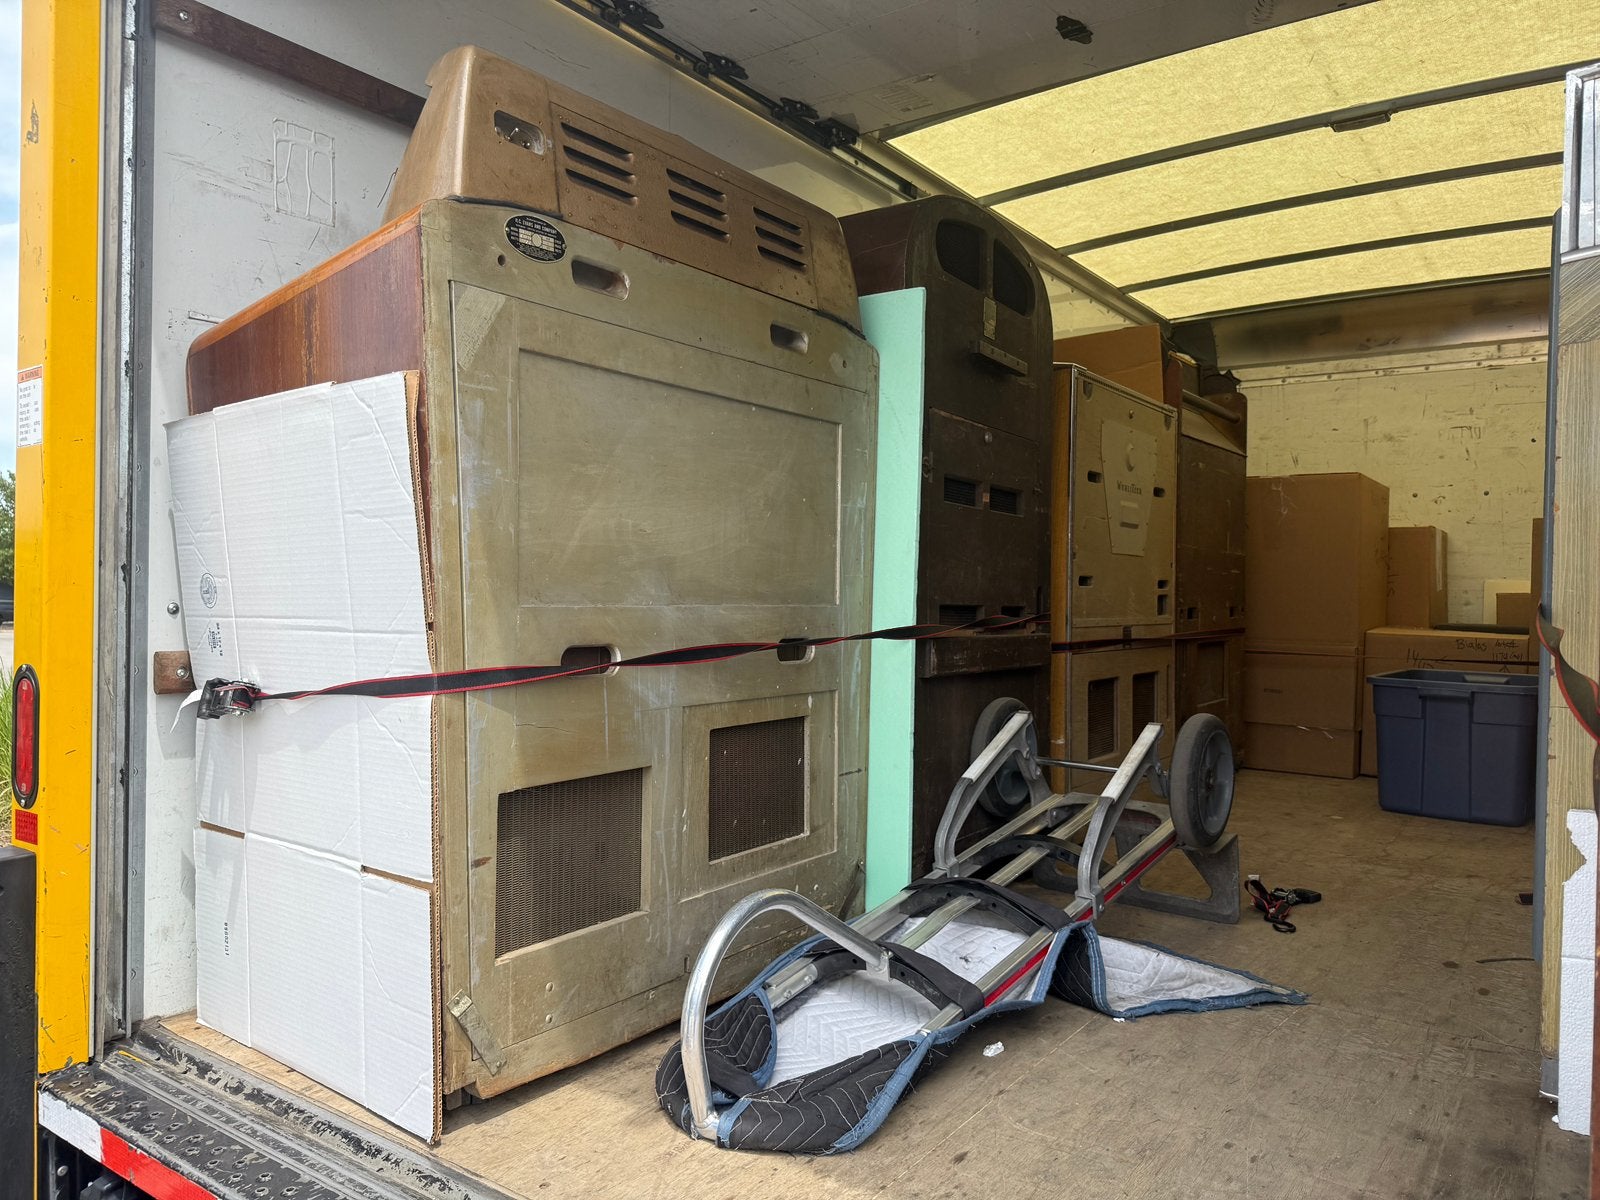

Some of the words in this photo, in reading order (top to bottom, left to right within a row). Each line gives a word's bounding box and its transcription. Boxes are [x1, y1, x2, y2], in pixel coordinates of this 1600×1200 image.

[522, 219, 534, 228] EVANS
[534, 222, 542, 230] AND
[541, 224, 558, 234] COMPANY
